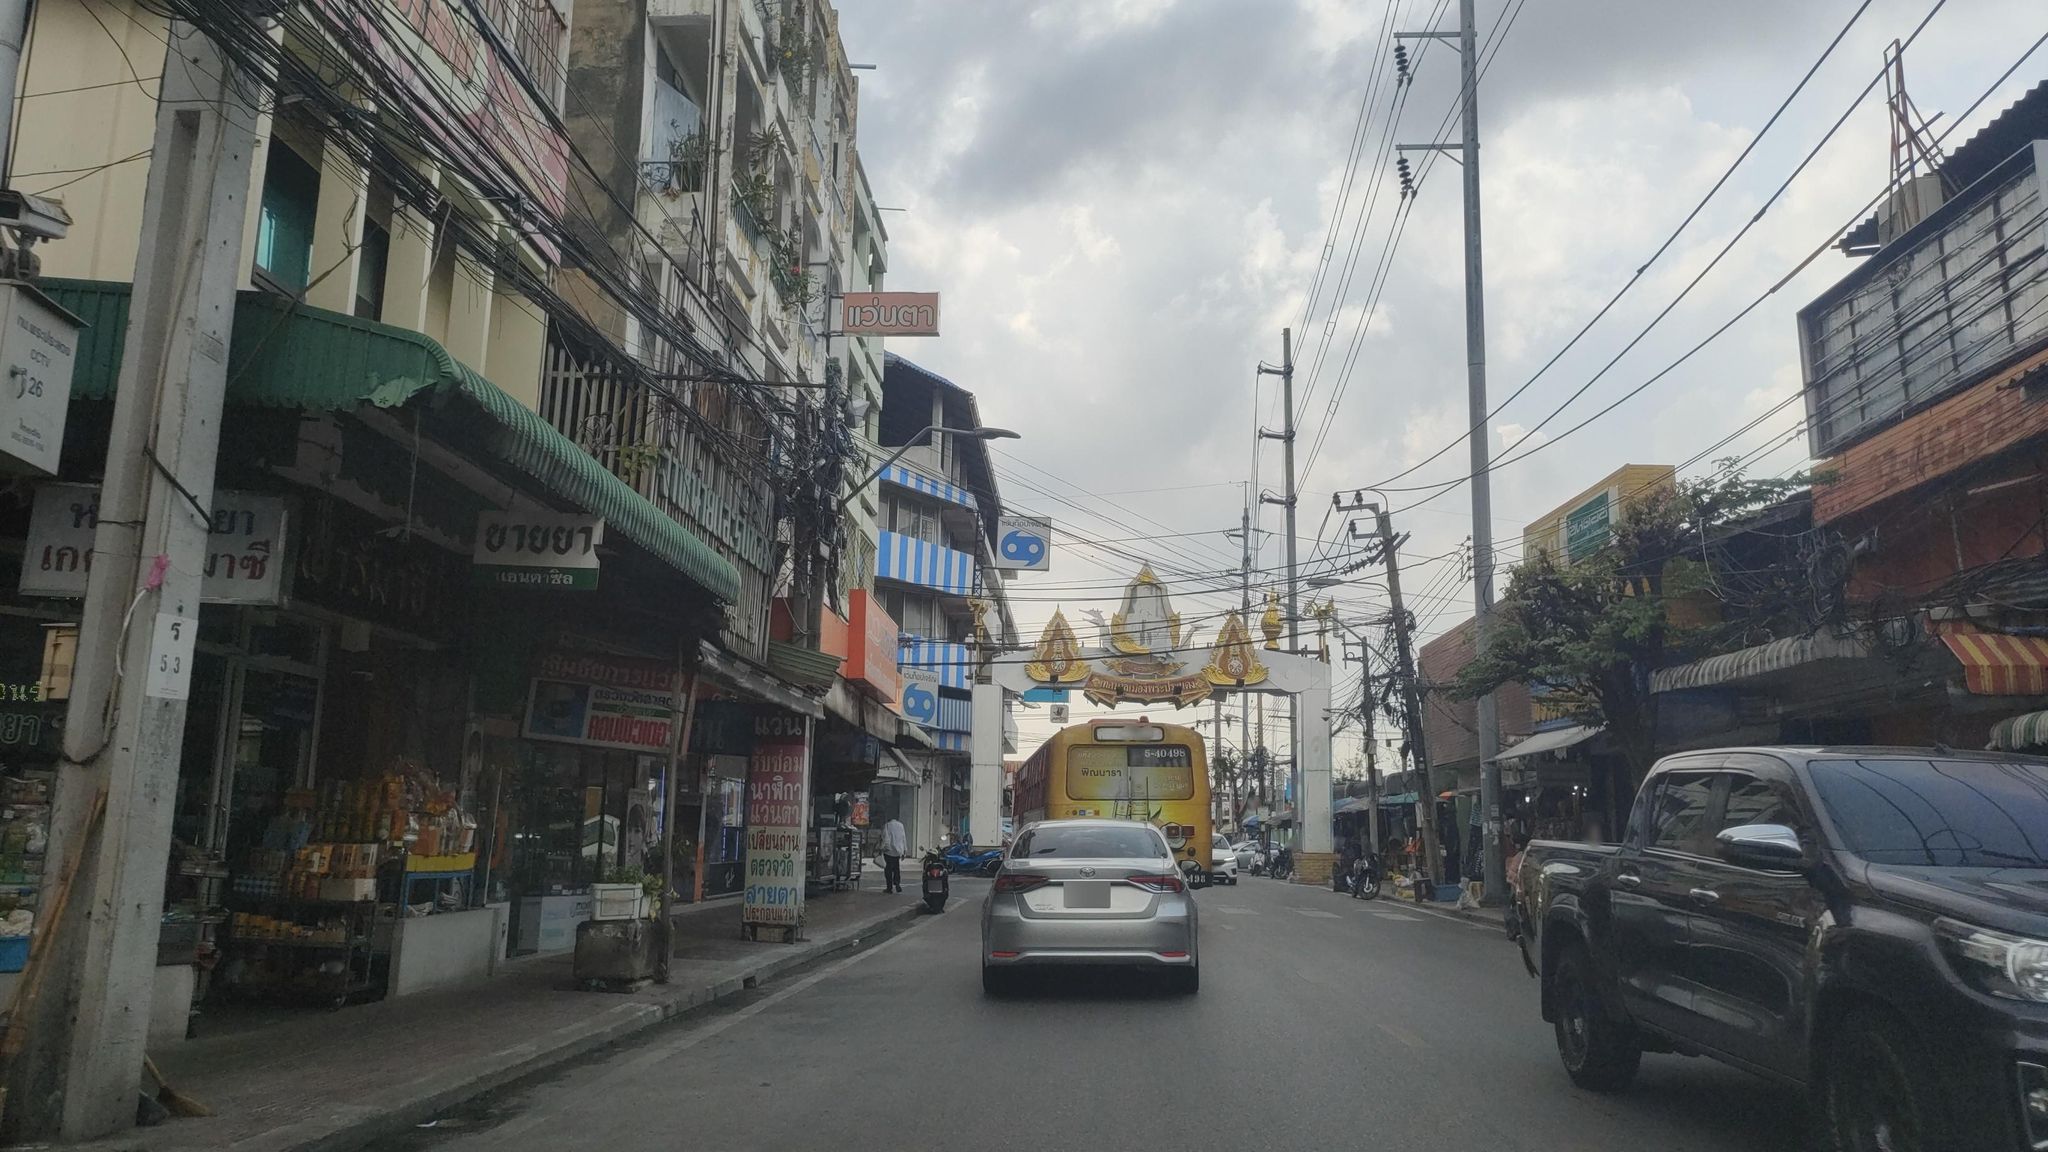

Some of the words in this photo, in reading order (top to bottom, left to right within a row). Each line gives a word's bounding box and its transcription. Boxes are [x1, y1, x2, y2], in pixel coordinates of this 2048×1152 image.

[847, 297, 934, 328] แว่นตา
[28, 377, 43, 398] 26
[485, 523, 594, 556] ขายยา
[752, 749, 803, 772] รับซ่อม
[1144, 748, 1186, 759] 5-40498
[751, 775, 802, 801] นาฬิกา
[751, 801, 801, 825] แว่นตา
[751, 853, 794, 877] ตรวจวัด
[745, 884, 798, 906] สายตา
